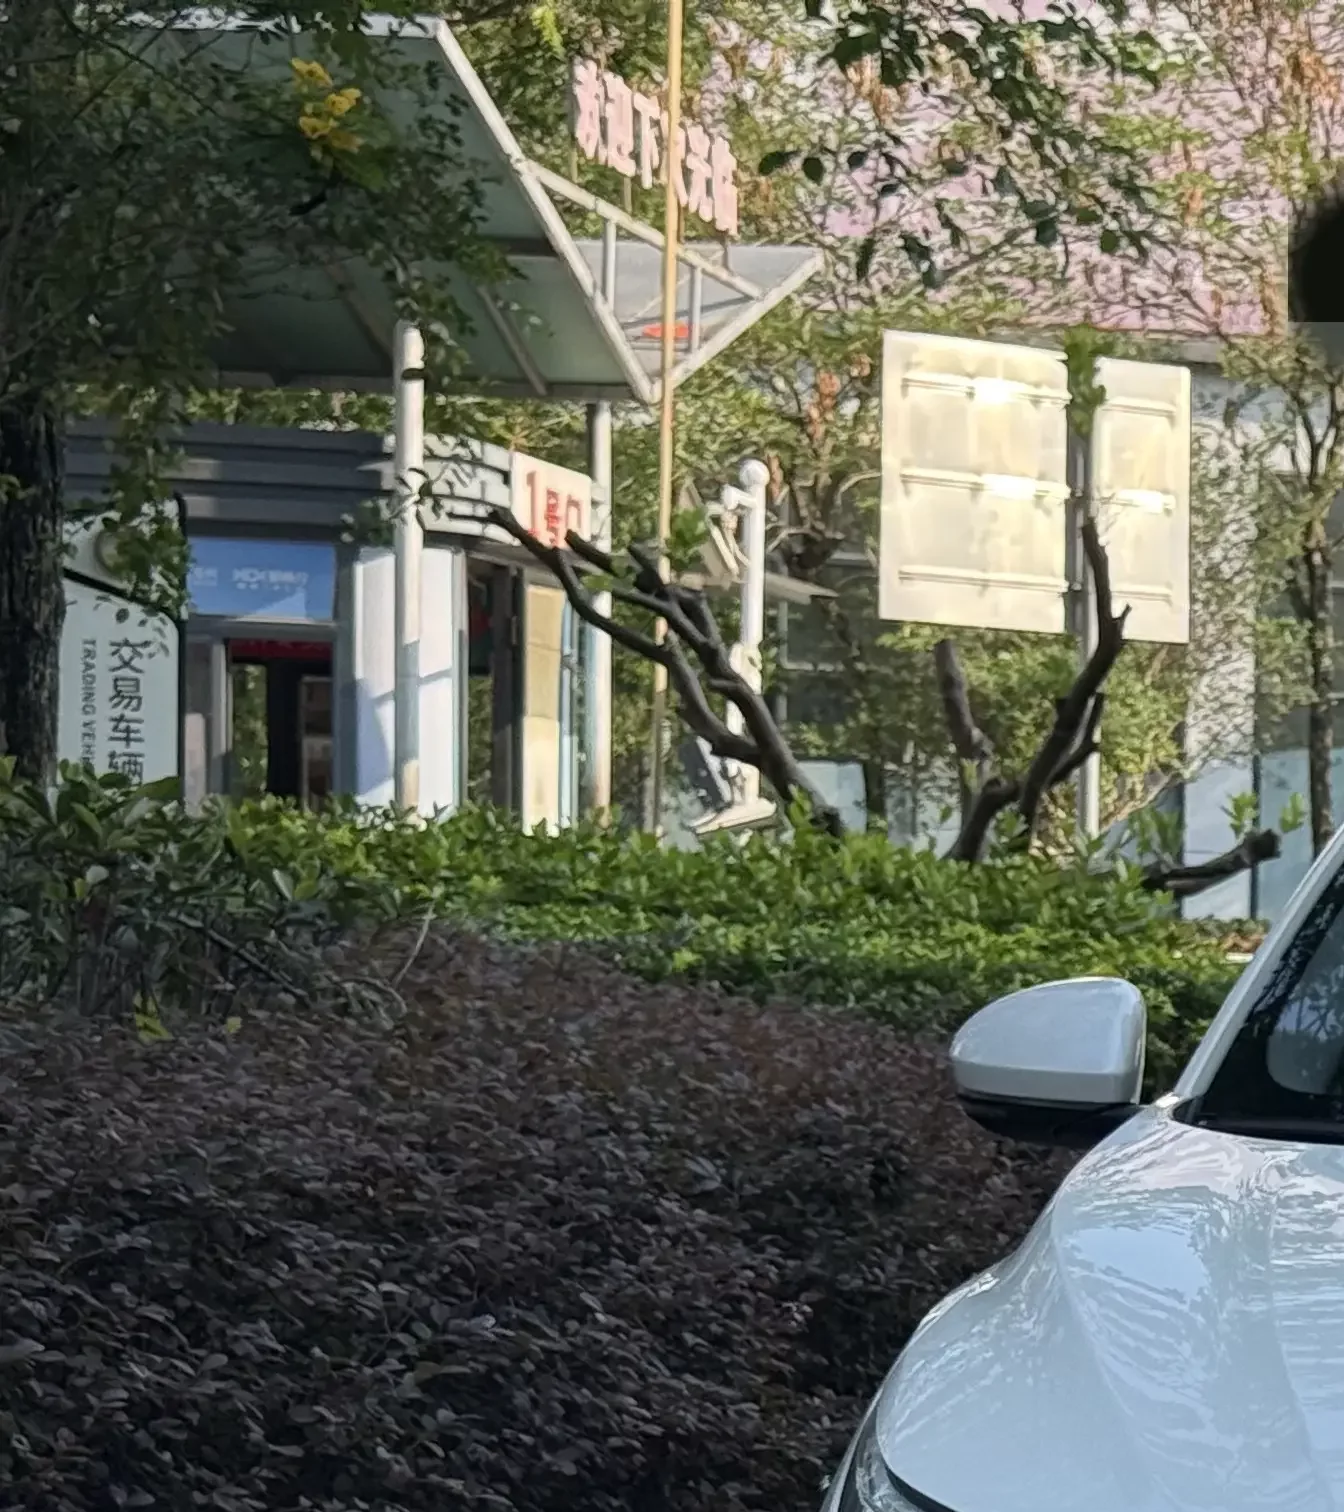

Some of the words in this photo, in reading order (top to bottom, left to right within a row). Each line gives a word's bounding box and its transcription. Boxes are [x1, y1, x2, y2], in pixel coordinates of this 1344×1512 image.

[81, 639, 96, 715] TRADING
[108, 638, 145, 785] 交易车辆
[81, 720, 96, 763] VEHI
